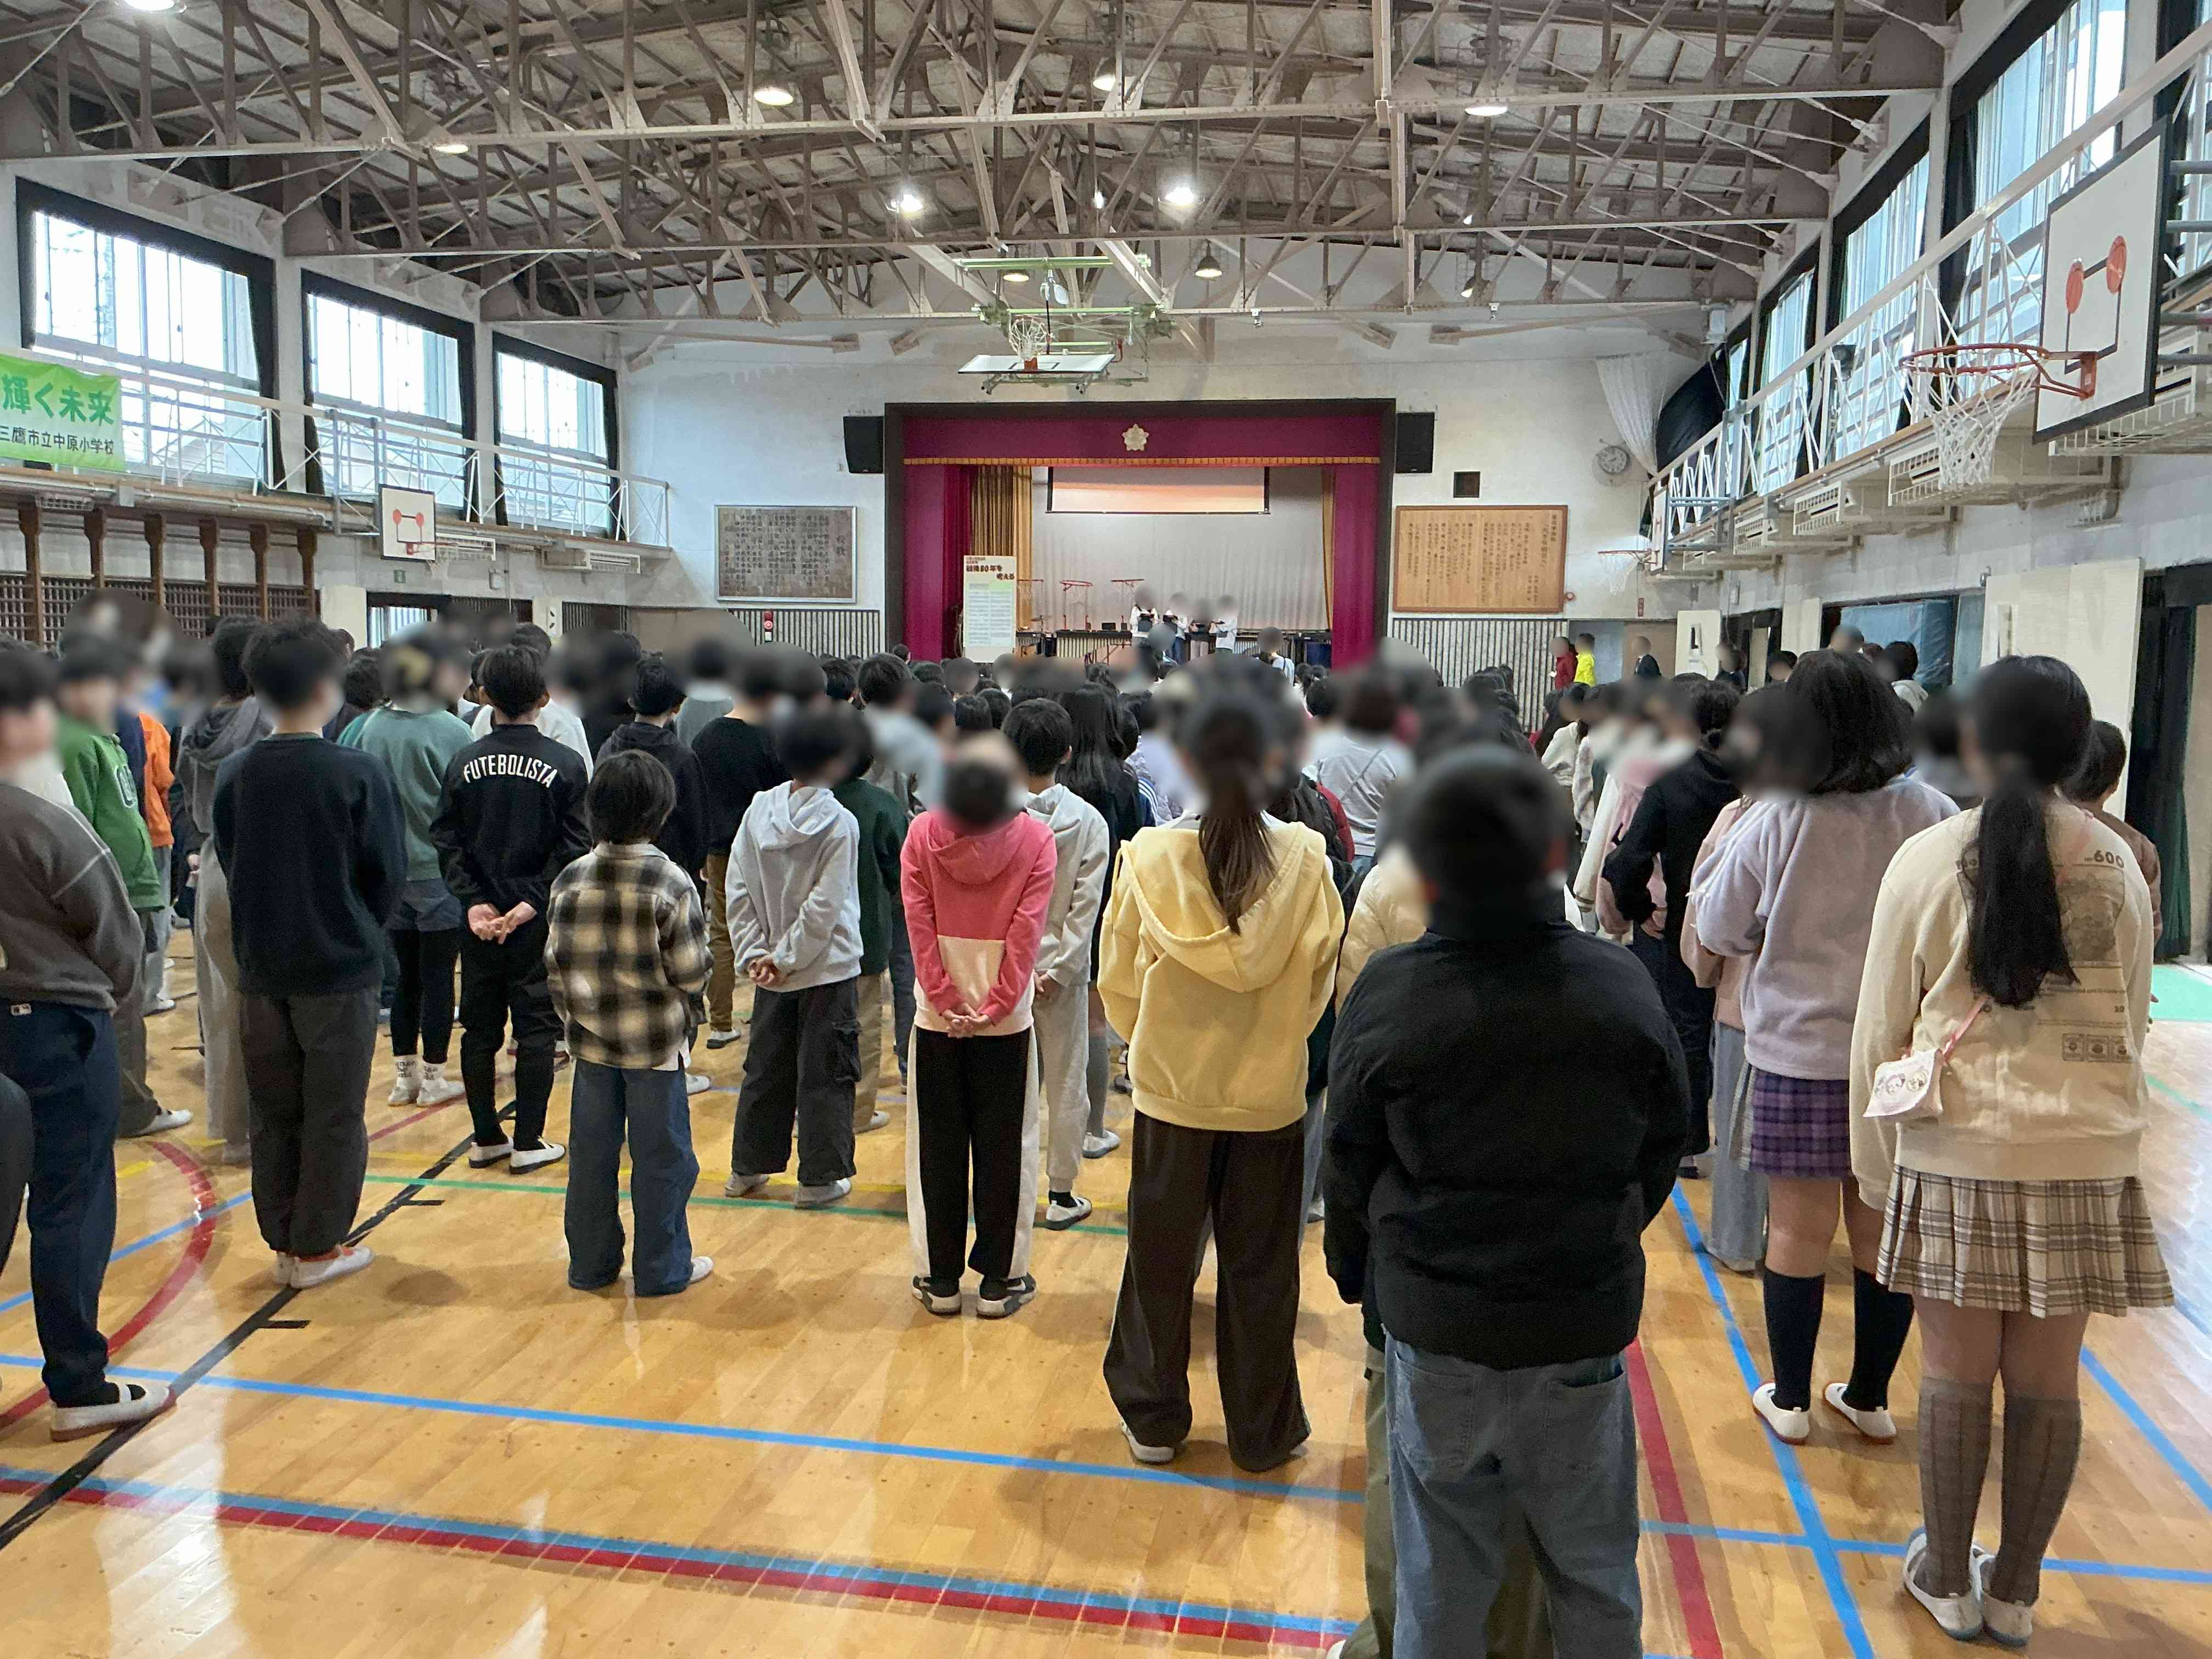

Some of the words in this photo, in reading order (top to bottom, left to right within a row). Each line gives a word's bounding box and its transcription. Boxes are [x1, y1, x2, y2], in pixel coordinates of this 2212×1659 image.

[2, 374, 115, 427] 輝く未来
[0, 425, 115, 456] 三鷹市立中原小学校
[463, 754, 558, 788] FUTEBOLISTA
